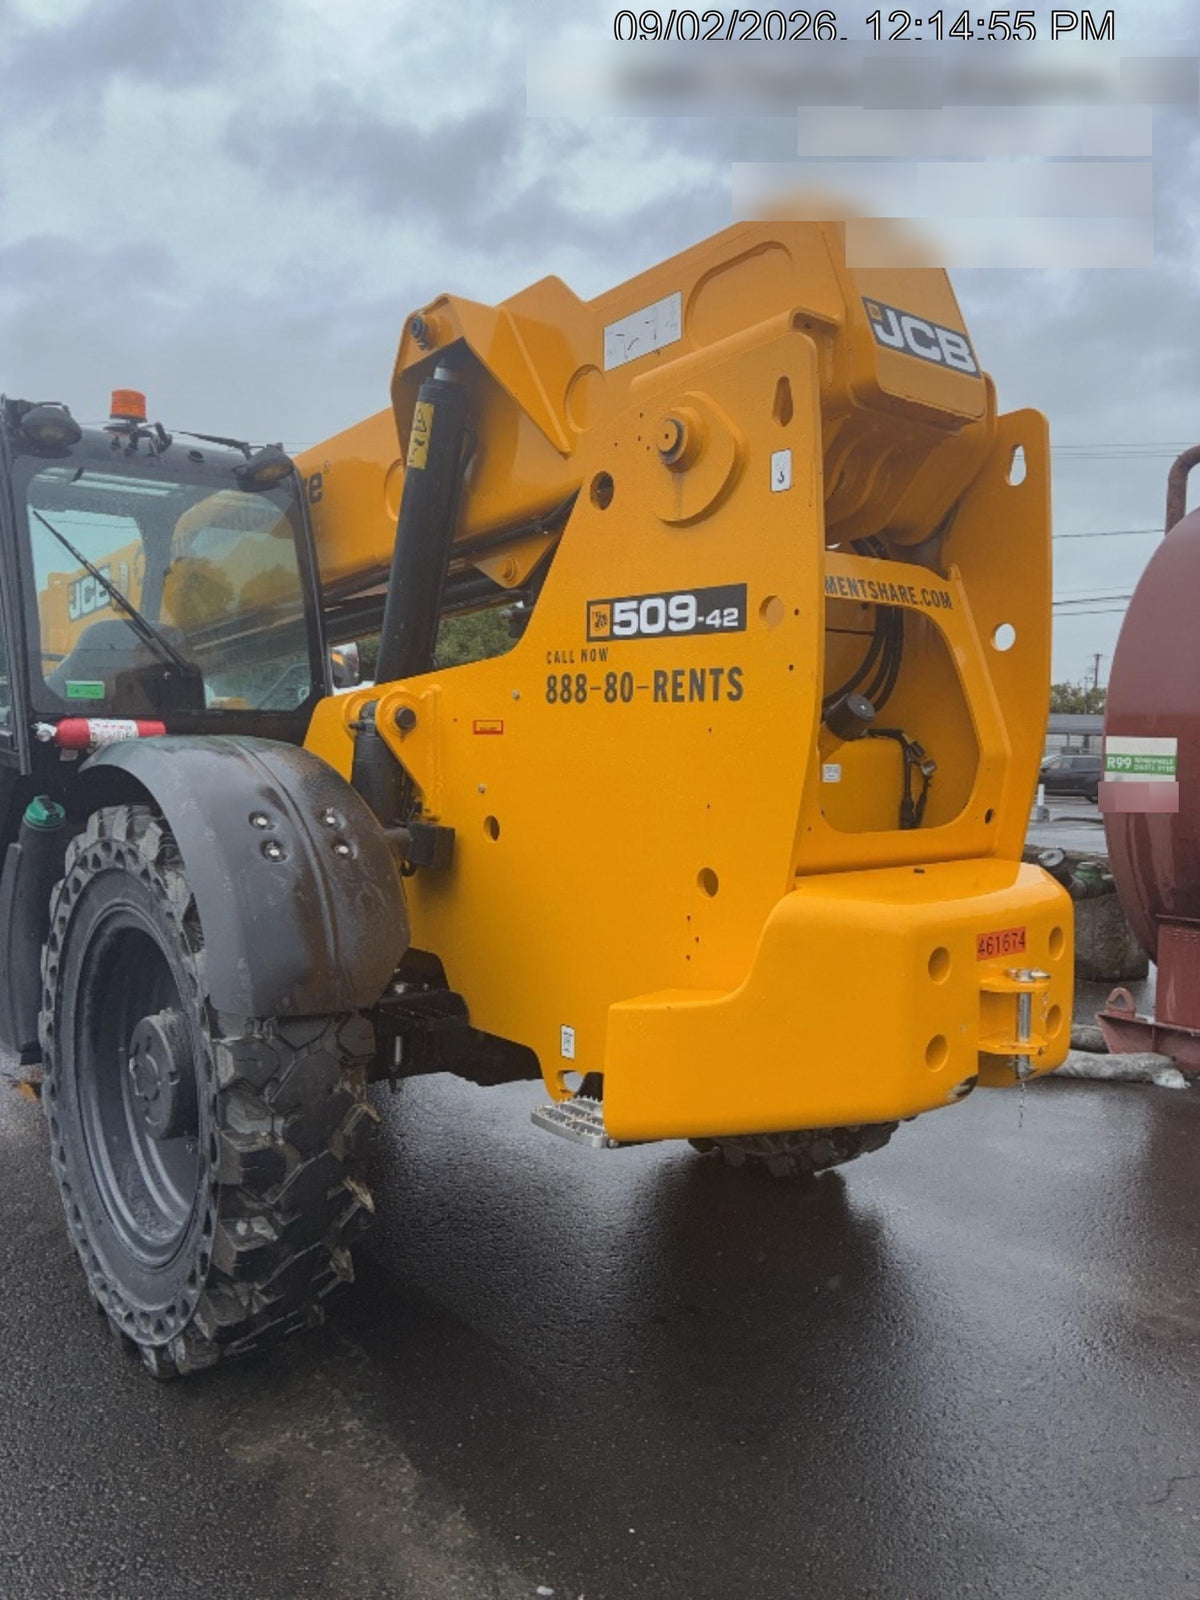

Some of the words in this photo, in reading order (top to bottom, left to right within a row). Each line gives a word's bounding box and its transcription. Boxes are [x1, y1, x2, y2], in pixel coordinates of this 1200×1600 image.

[872, 308, 978, 373] JCB
[612, 594, 740, 636] 509-42
[546, 650, 576, 665] CALL
[580, 647, 609, 662] NOW
[546, 666, 744, 704] 888-80-RENTS
[1107, 756, 1132, 769] R99
[977, 931, 1026, 955] 461674
